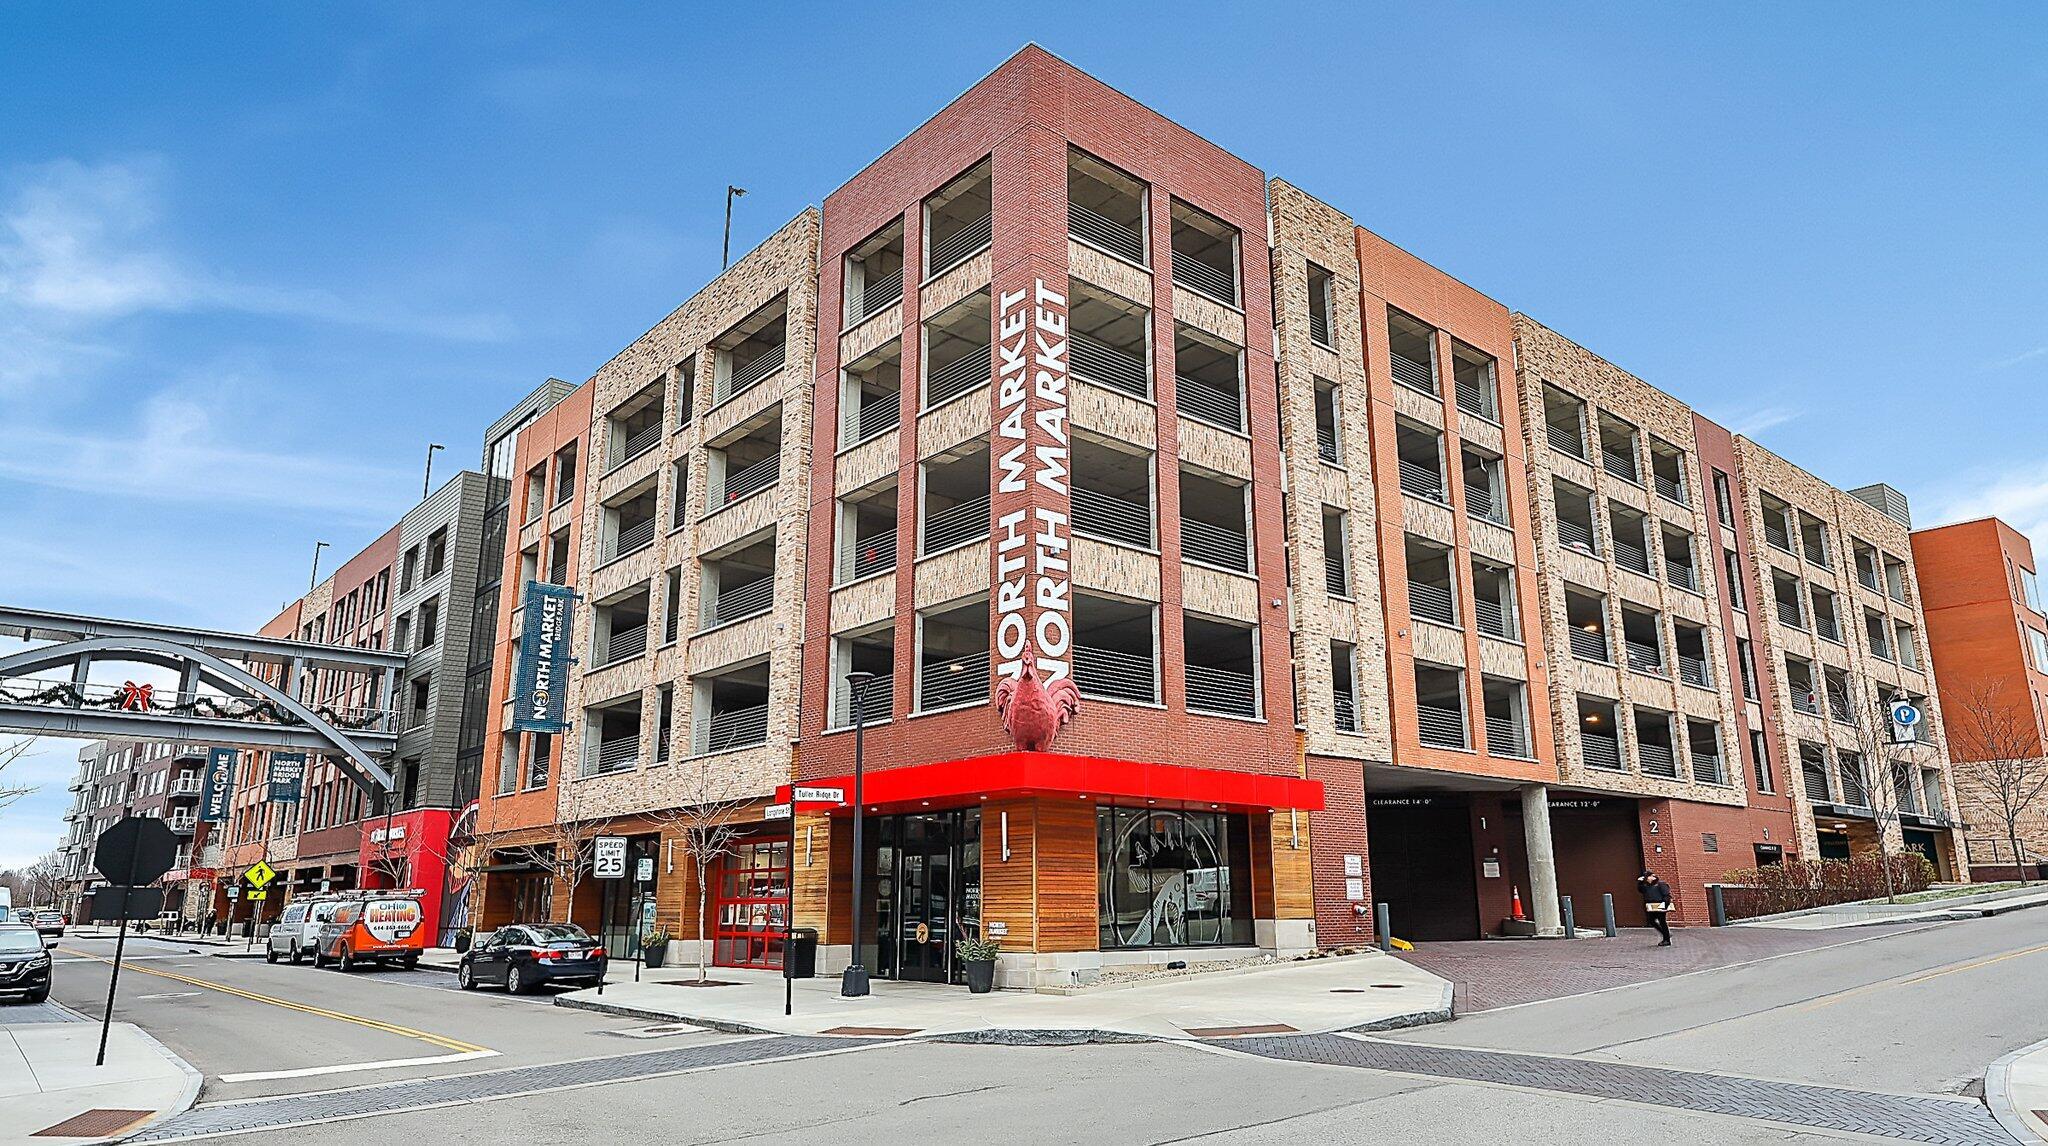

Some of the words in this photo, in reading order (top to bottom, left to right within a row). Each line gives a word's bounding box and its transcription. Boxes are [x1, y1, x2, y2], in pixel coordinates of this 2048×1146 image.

[998, 289, 1027, 494] MARKET
[1035, 277, 1069, 496] MARKET
[557, 598, 566, 616] PARK
[539, 594, 558, 660] MARKET
[554, 616, 563, 641] BRIDGE
[532, 660, 551, 720] NORTH
[274, 759, 301, 767] NORTH
[272, 771, 300, 779] BRIDGE
[209, 753, 230, 816] WELCOME
[798, 790, 814, 798] Tuller
[815, 790, 831, 799] Ridge
[832, 791, 840, 799] Dr
[1480, 817, 1487, 830] 1
[1649, 820, 1659, 833] 2
[1762, 827, 1769, 840] 3
[1904, 842, 1927, 852] ARK
[597, 858, 622, 872] 25
[369, 908, 416, 923] HEATING
